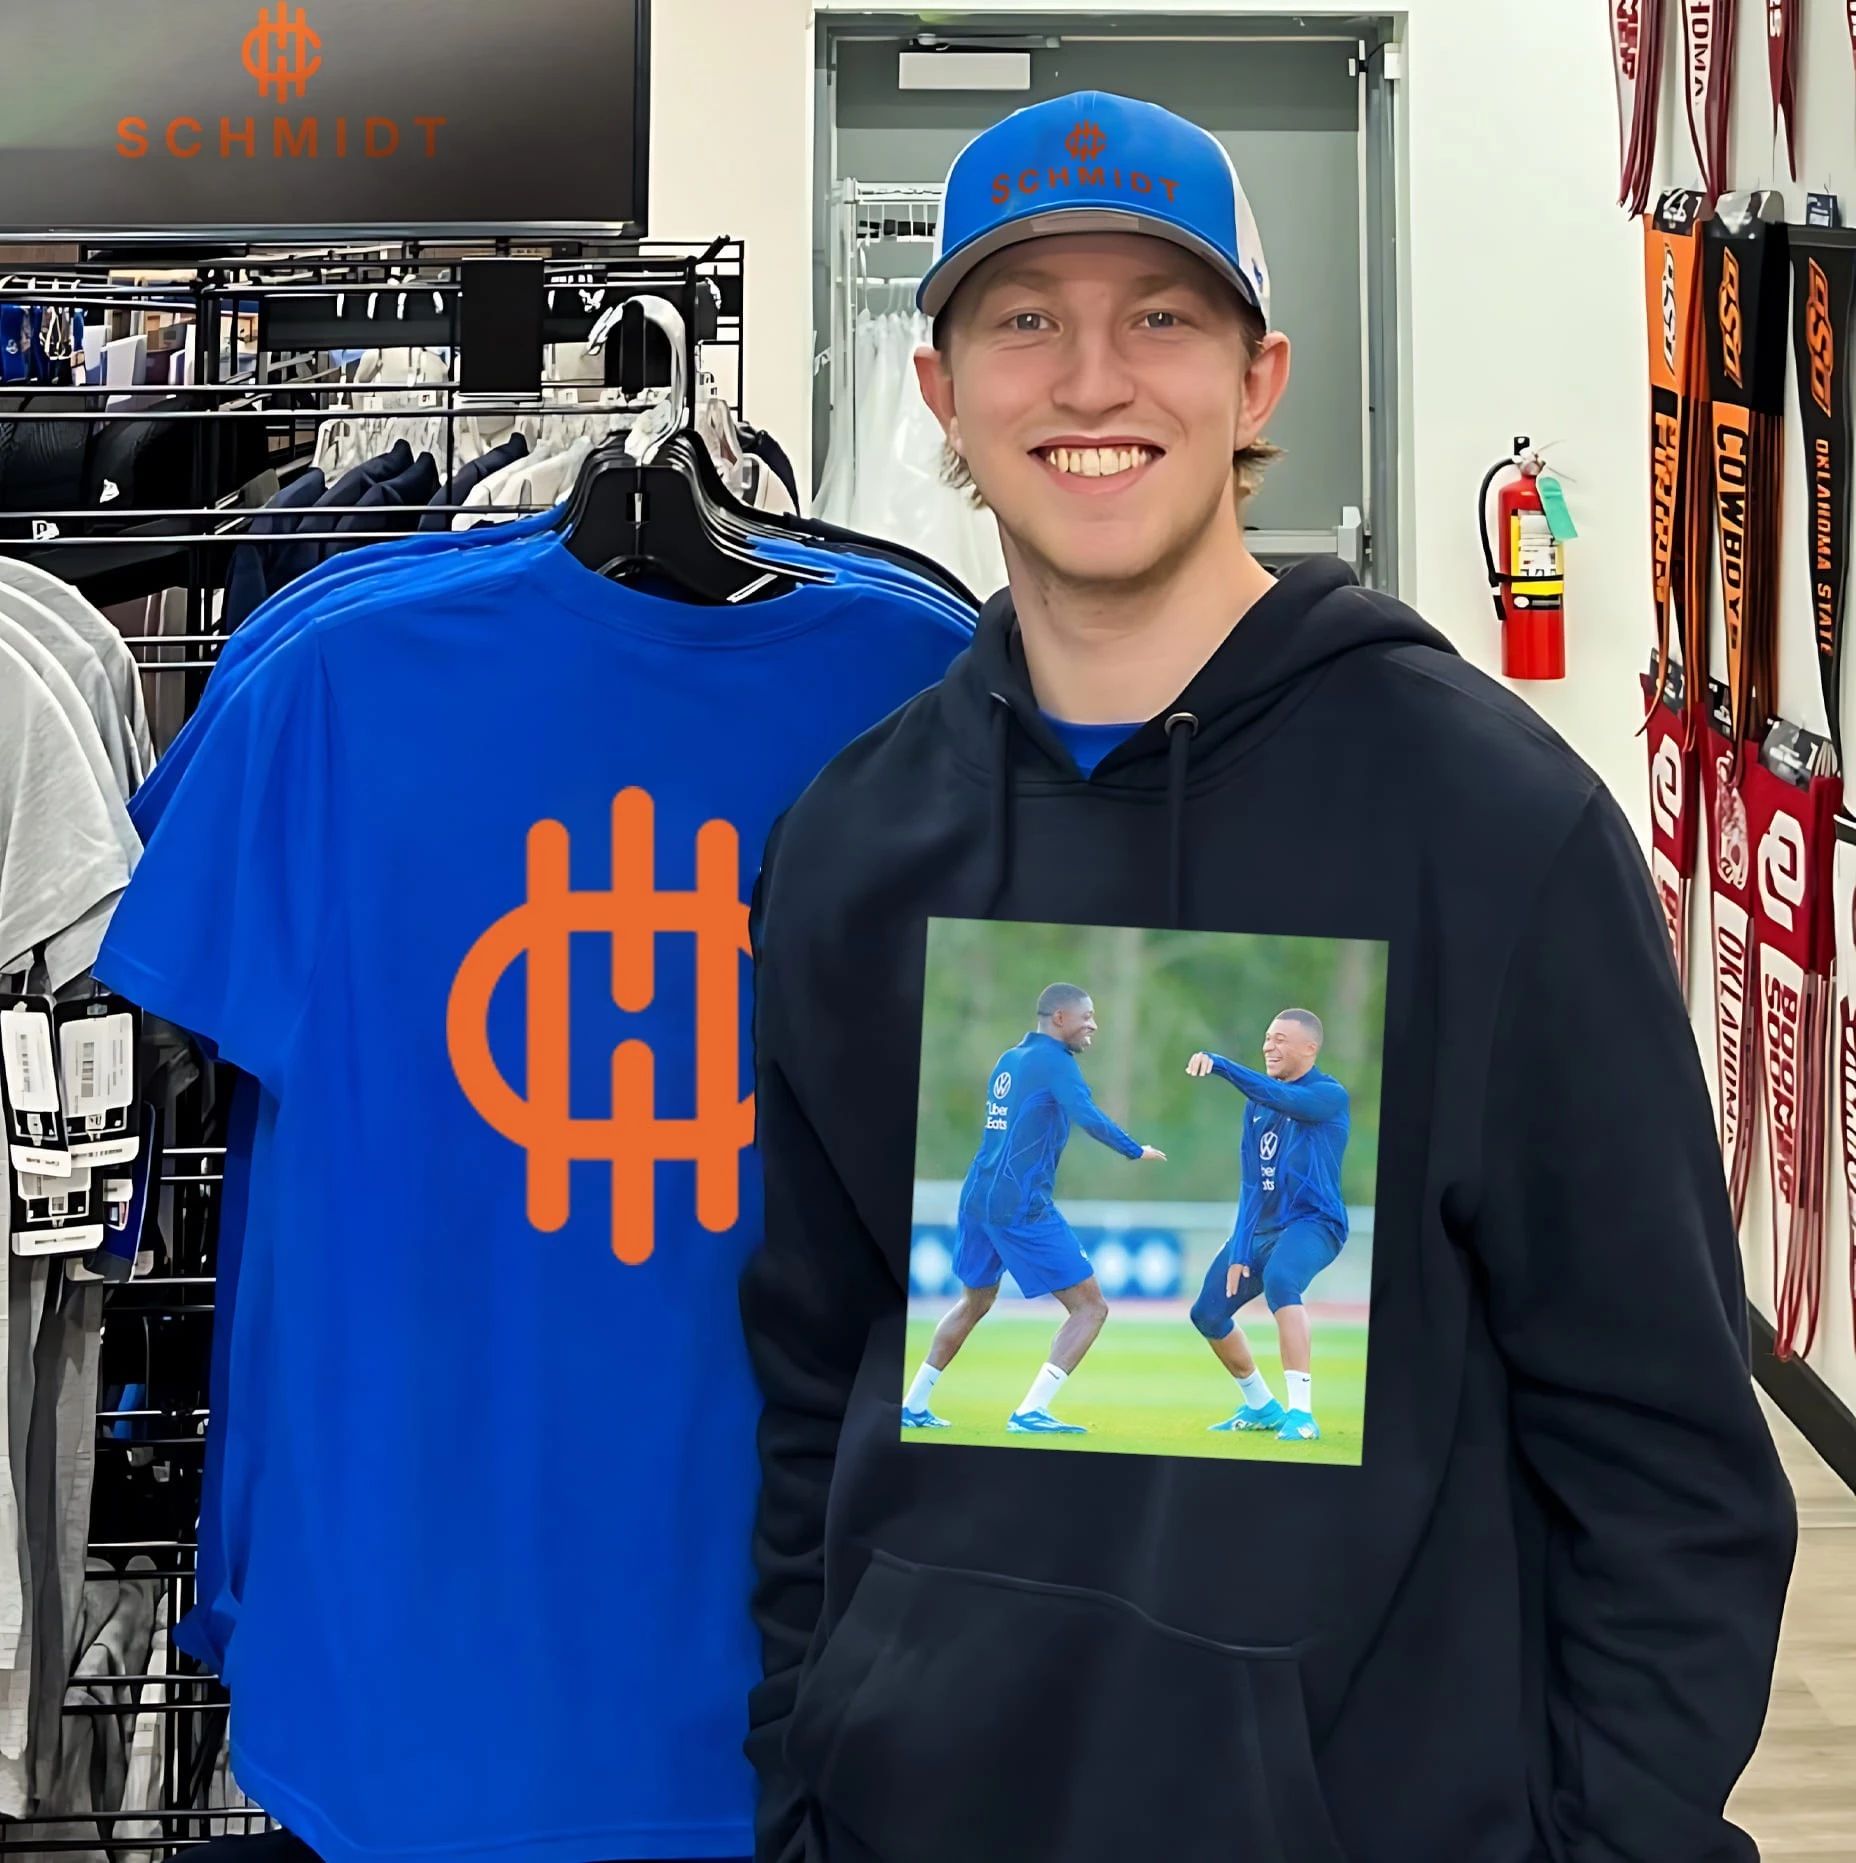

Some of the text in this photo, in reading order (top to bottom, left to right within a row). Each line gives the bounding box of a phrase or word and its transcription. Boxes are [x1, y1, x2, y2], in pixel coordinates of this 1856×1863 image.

[116, 116, 448, 159] SCHMIDT
[991, 167, 1181, 205] SCHMIDT
[1815, 438, 1832, 570] OKLAHOMA
[1718, 925, 1745, 1144] OKLAHOMA
